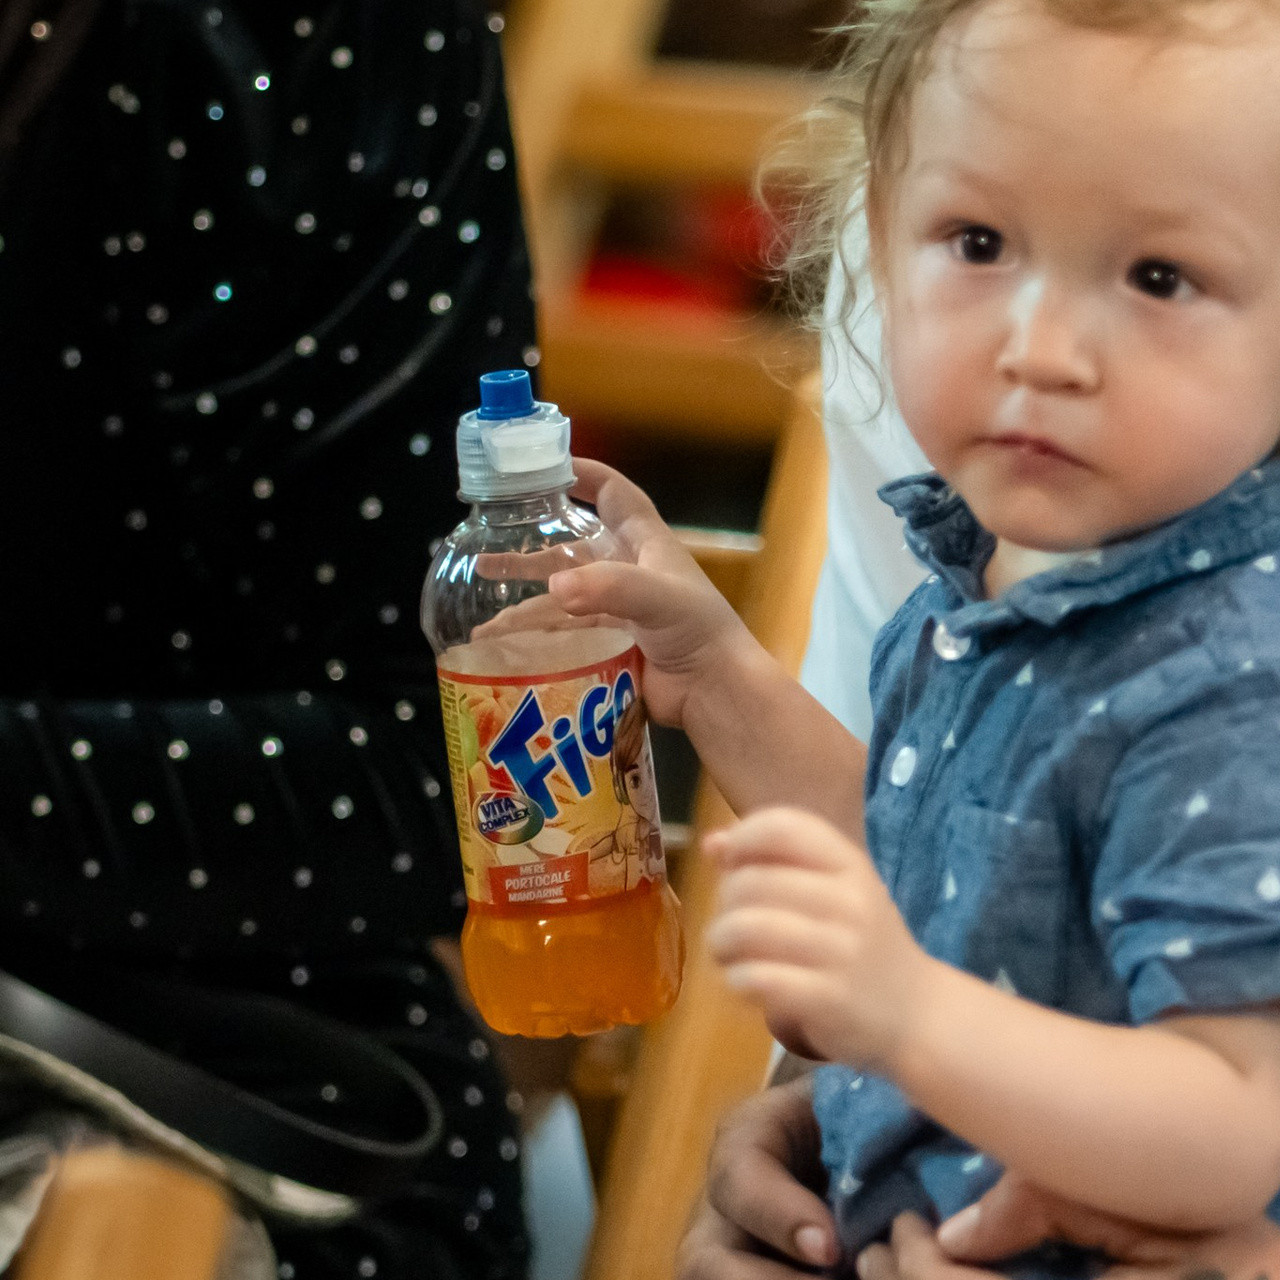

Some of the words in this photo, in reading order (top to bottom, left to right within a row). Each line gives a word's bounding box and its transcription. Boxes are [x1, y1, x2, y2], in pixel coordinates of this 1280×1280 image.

[480, 797, 517, 819] VITA
[479, 807, 531, 833] COMPLEX
[519, 863, 546, 876] MERE
[505, 870, 571, 891] PORTOCALE
[508, 886, 565, 903] MANDARINE
